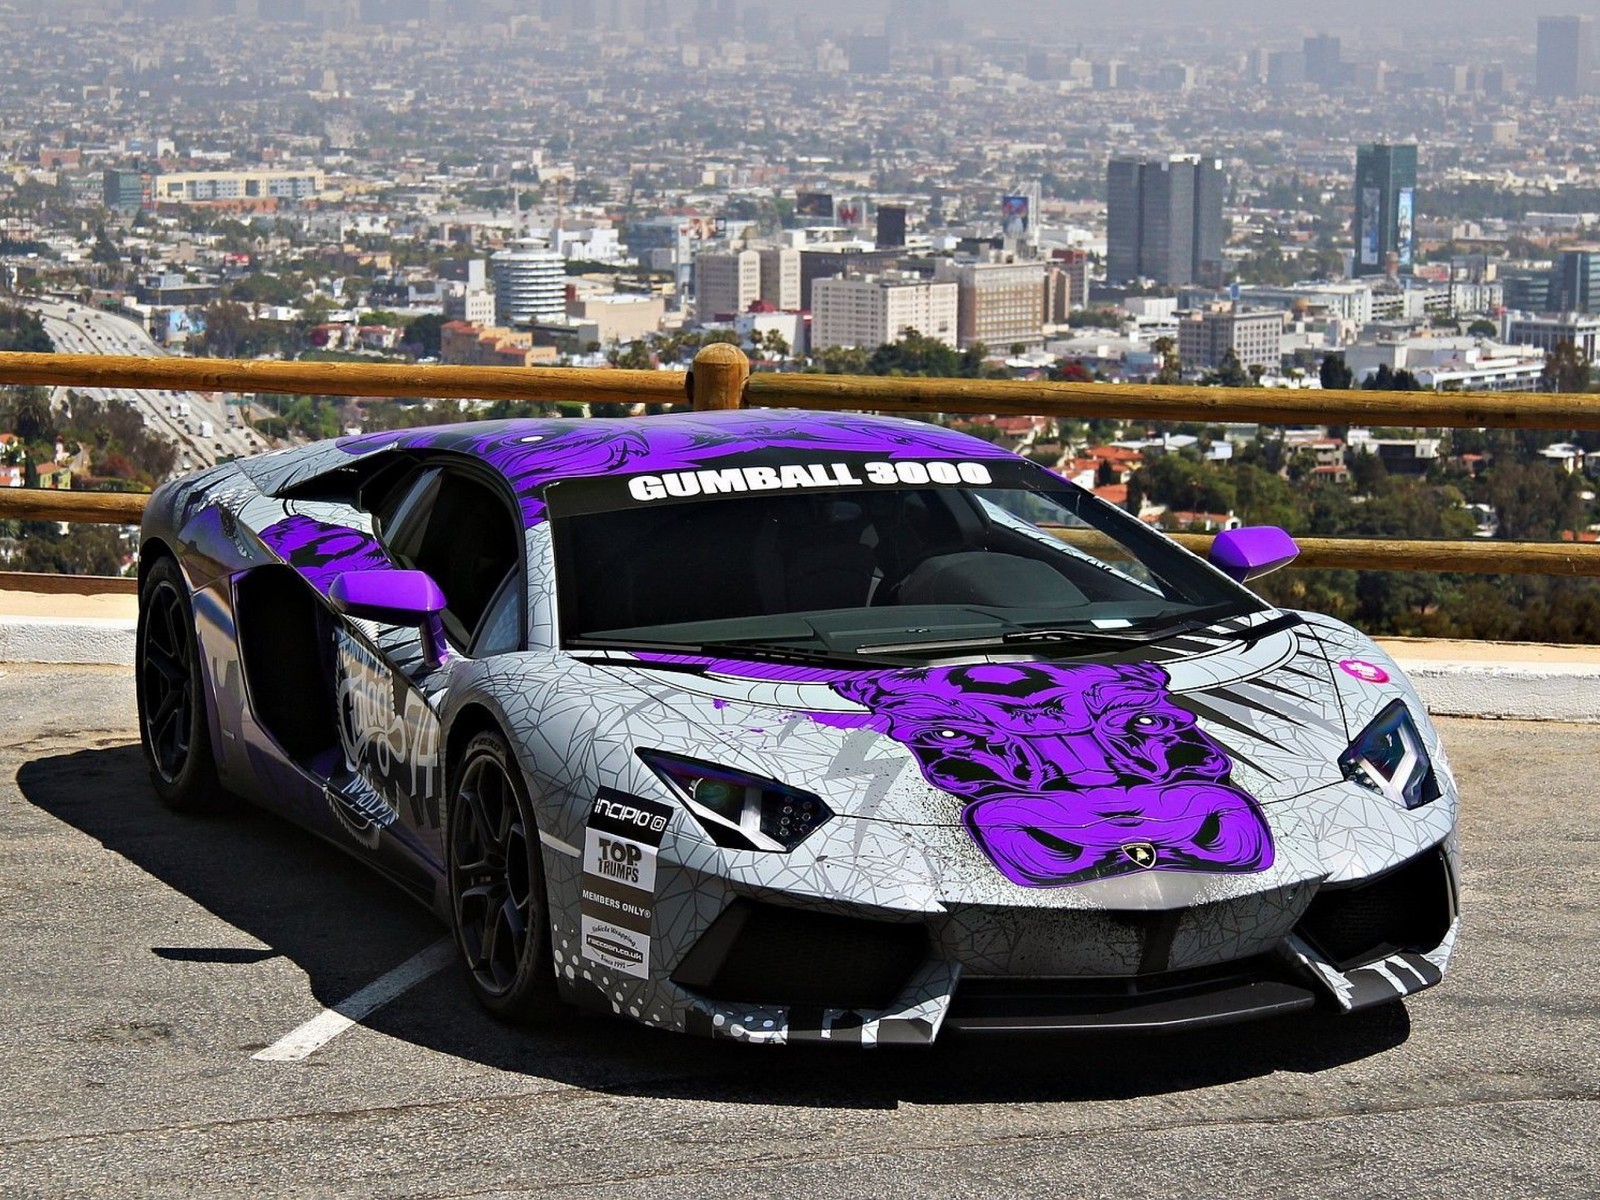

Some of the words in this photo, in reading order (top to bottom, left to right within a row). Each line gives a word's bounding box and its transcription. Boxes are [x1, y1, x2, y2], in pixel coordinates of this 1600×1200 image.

[628, 463, 863, 502] GUMBALL
[864, 461, 992, 485] 3000
[599, 838, 642, 866] TOP
[598, 858, 639, 884] TRUMPS
[582, 889, 620, 910] MEMBERS
[588, 937, 642, 960] raccoon.co.uk
